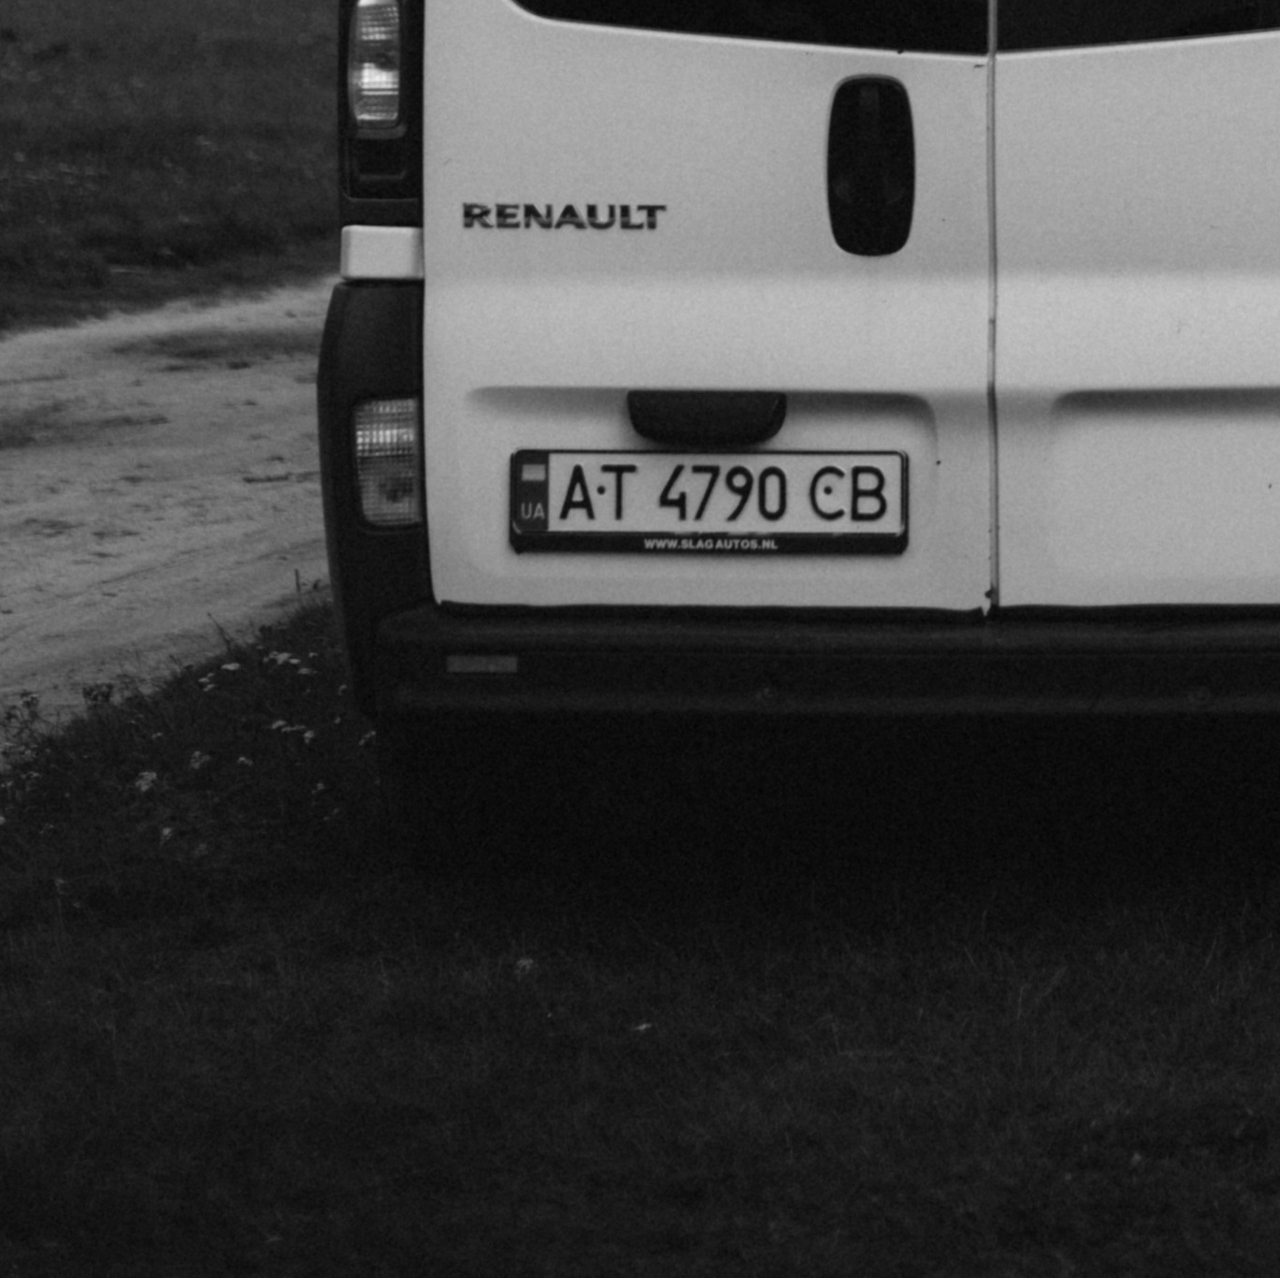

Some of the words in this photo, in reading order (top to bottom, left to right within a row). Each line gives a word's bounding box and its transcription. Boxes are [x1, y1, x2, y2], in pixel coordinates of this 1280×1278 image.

[462, 202, 668, 231] RENAULT
[658, 464, 788, 522] 4790
[809, 465, 888, 522] CB
[520, 502, 546, 521] UA
